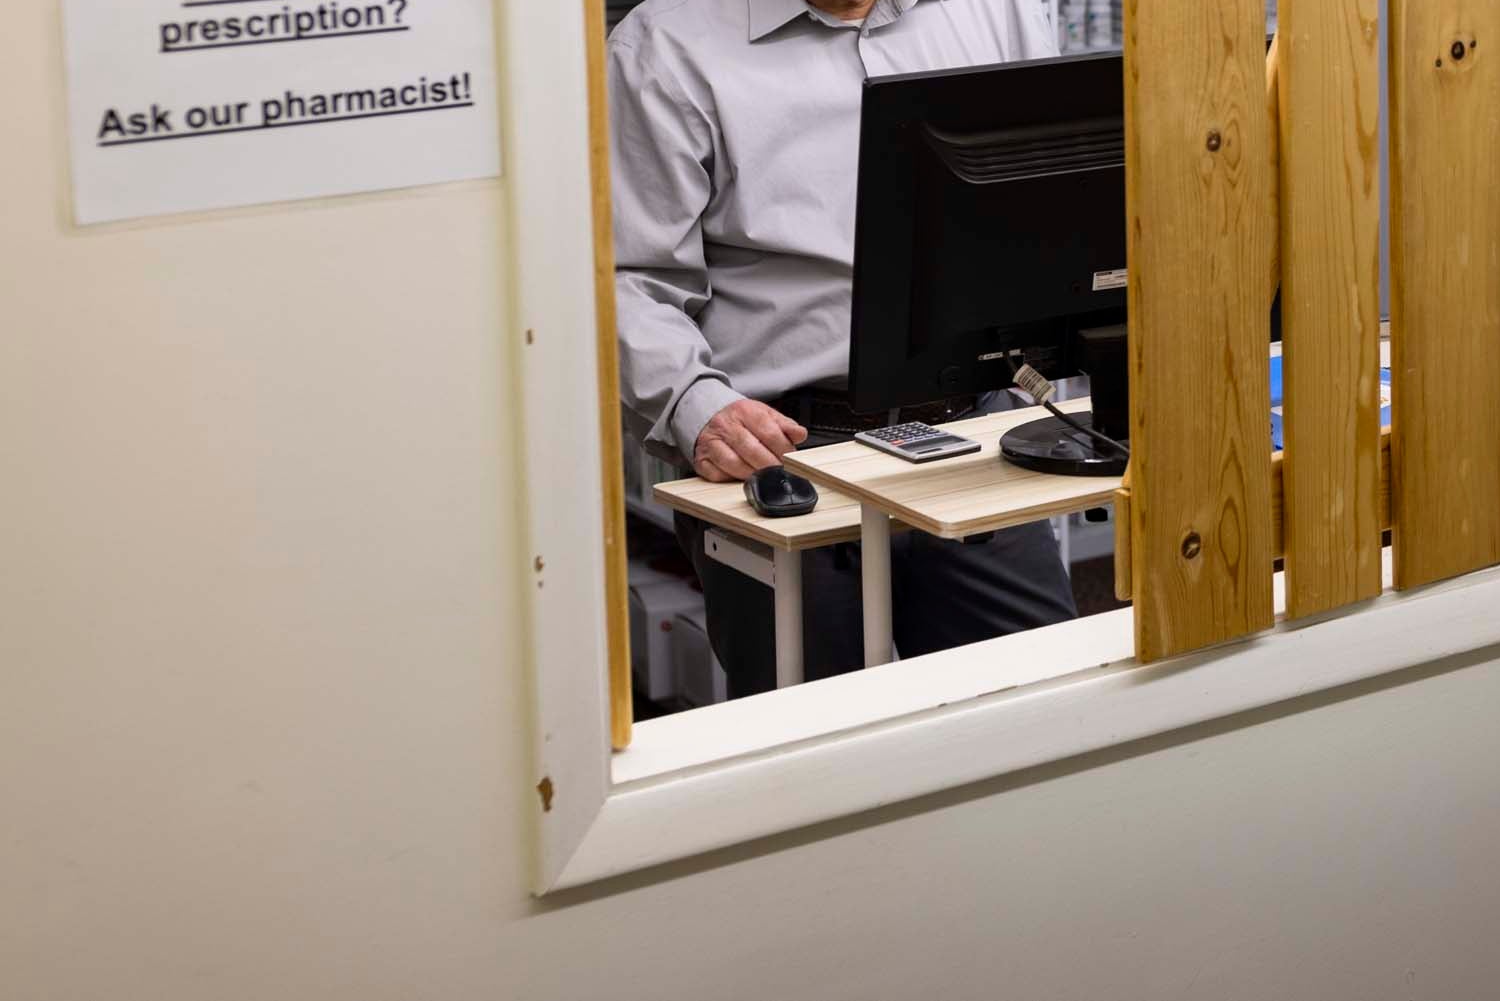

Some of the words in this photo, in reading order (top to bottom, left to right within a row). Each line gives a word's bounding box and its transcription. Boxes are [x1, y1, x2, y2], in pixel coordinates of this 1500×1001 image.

[98, 104, 174, 141] Ask
[185, 101, 249, 132] our
[261, 72, 472, 129] pharmacist!
